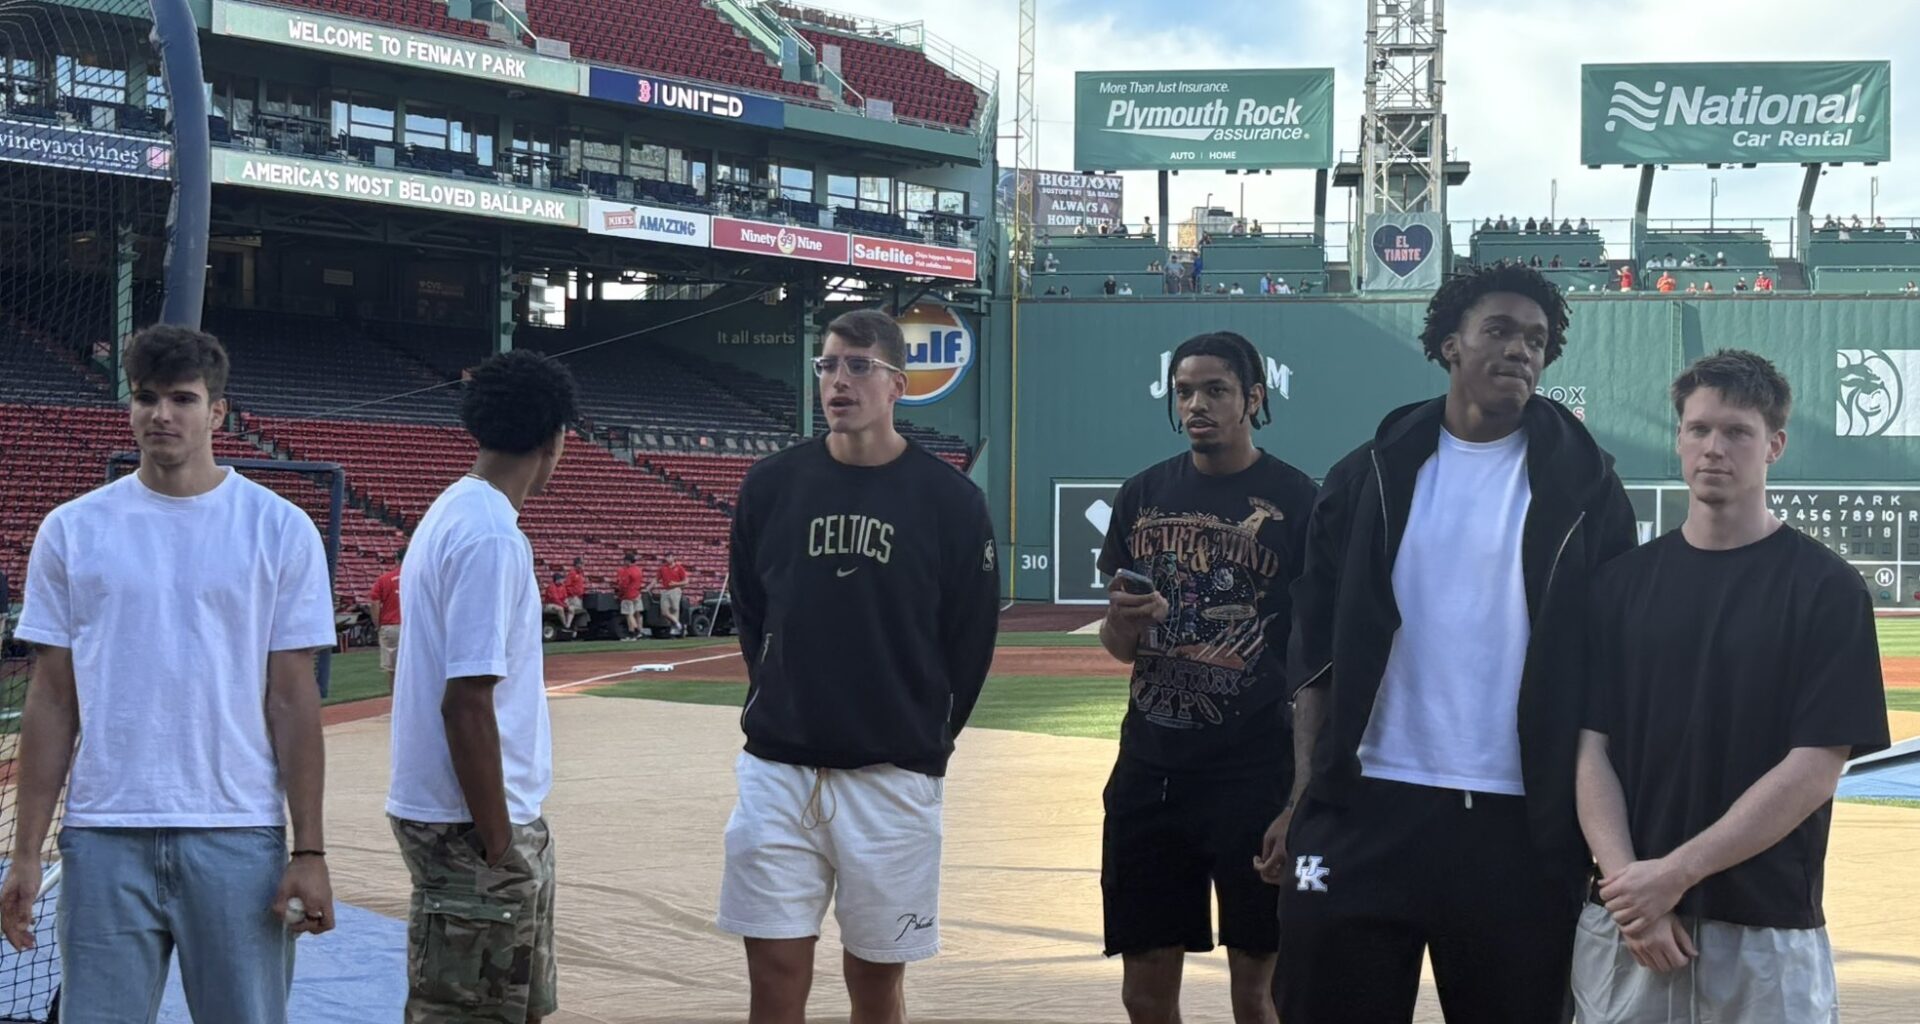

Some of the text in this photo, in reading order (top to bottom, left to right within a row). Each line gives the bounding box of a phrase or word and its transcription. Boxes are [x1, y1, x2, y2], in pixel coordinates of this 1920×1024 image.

[288, 18, 527, 78] WELCOME TO FENWAY PARK
[1100, 81, 1230, 94] More Than Just Insurance.
[662, 84, 743, 117] UNITED
[1664, 84, 1862, 125] National
[1106, 97, 1303, 130] Plymouth Rock
[1213, 126, 1303, 141] assurance
[1733, 129, 1852, 147] Car Rental
[0, 130, 86, 158] vineyard
[87, 141, 140, 164] vines
[1170, 151, 1237, 160] AUTO HOME
[242, 160, 565, 219] AMERICA'S MOST BELOVED BALLPARK
[608, 215, 696, 236] MIKE'S AMAZING
[740, 228, 776, 247] Ninety
[797, 235, 823, 251] Nine
[1395, 235, 1409, 248] EL
[854, 243, 914, 265] Safelite
[1384, 248, 1421, 261] TIANTE
[718, 330, 727, 344] It
[731, 329, 749, 344] all
[753, 331, 796, 344] starts
[906, 331, 963, 363] ulf
[1771, 494, 1902, 506] WAY PARK
[1881, 509, 1895, 522] 10
[808, 514, 895, 564] CELTICS
[1021, 554, 1048, 569] 310
